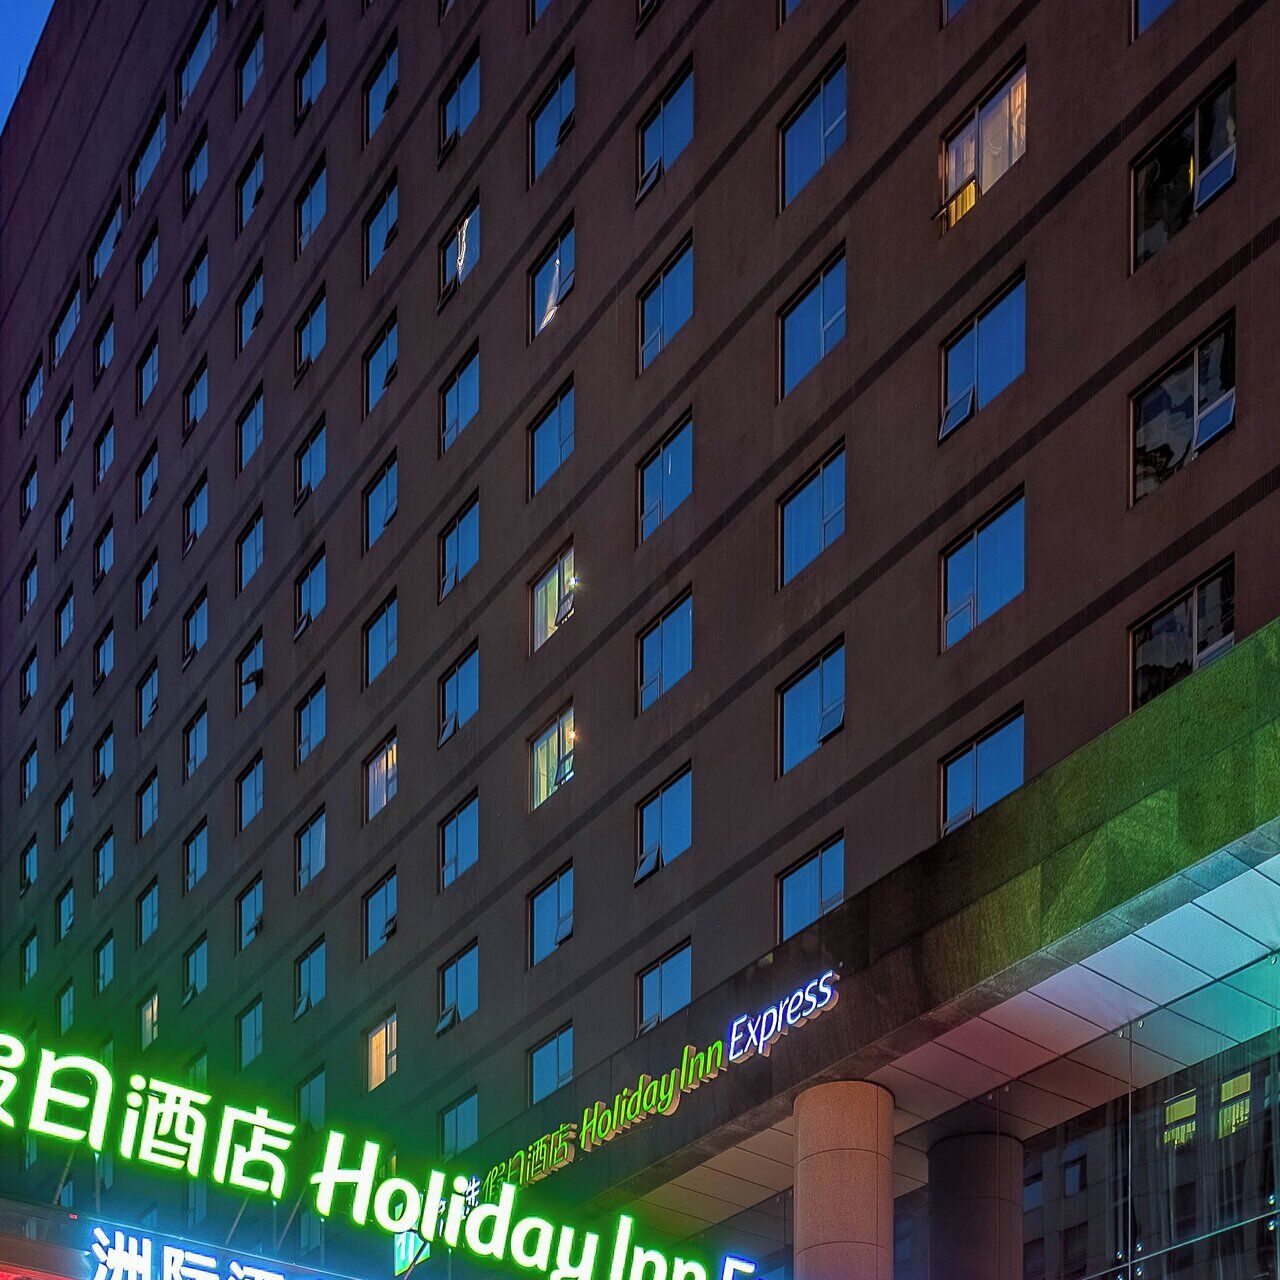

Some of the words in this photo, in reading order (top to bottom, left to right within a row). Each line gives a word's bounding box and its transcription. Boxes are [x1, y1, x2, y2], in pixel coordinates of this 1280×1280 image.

[579, 1067, 678, 1150] Holiday
[680, 1037, 725, 1088] Inn
[727, 969, 837, 1063] Express
